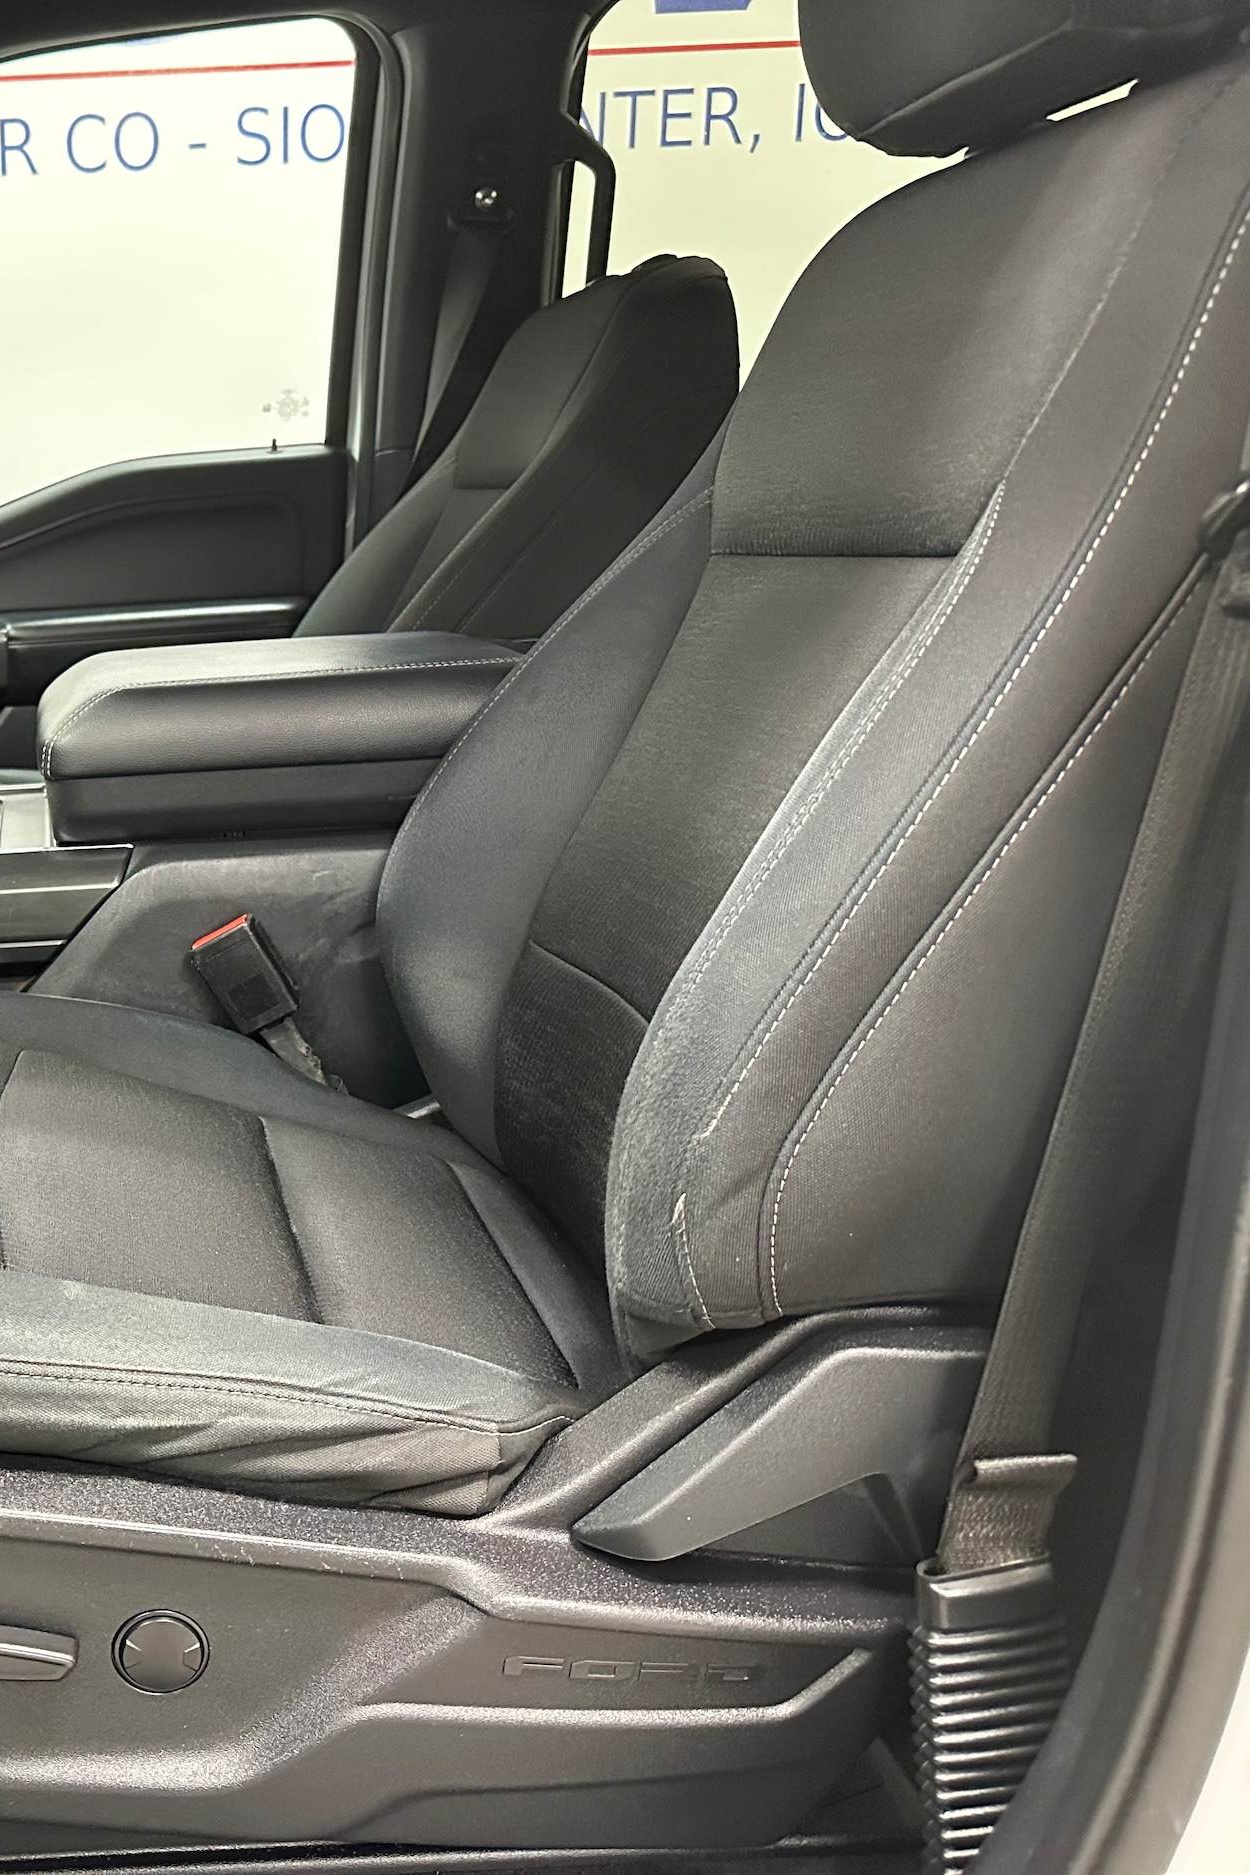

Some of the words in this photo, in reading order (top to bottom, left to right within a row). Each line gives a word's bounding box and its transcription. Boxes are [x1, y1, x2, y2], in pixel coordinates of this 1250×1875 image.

[66, 111, 159, 173] CO
[237, 104, 346, 166] SIO
[580, 86, 761, 154] NTER,
[502, 1656, 757, 1682] FORD
